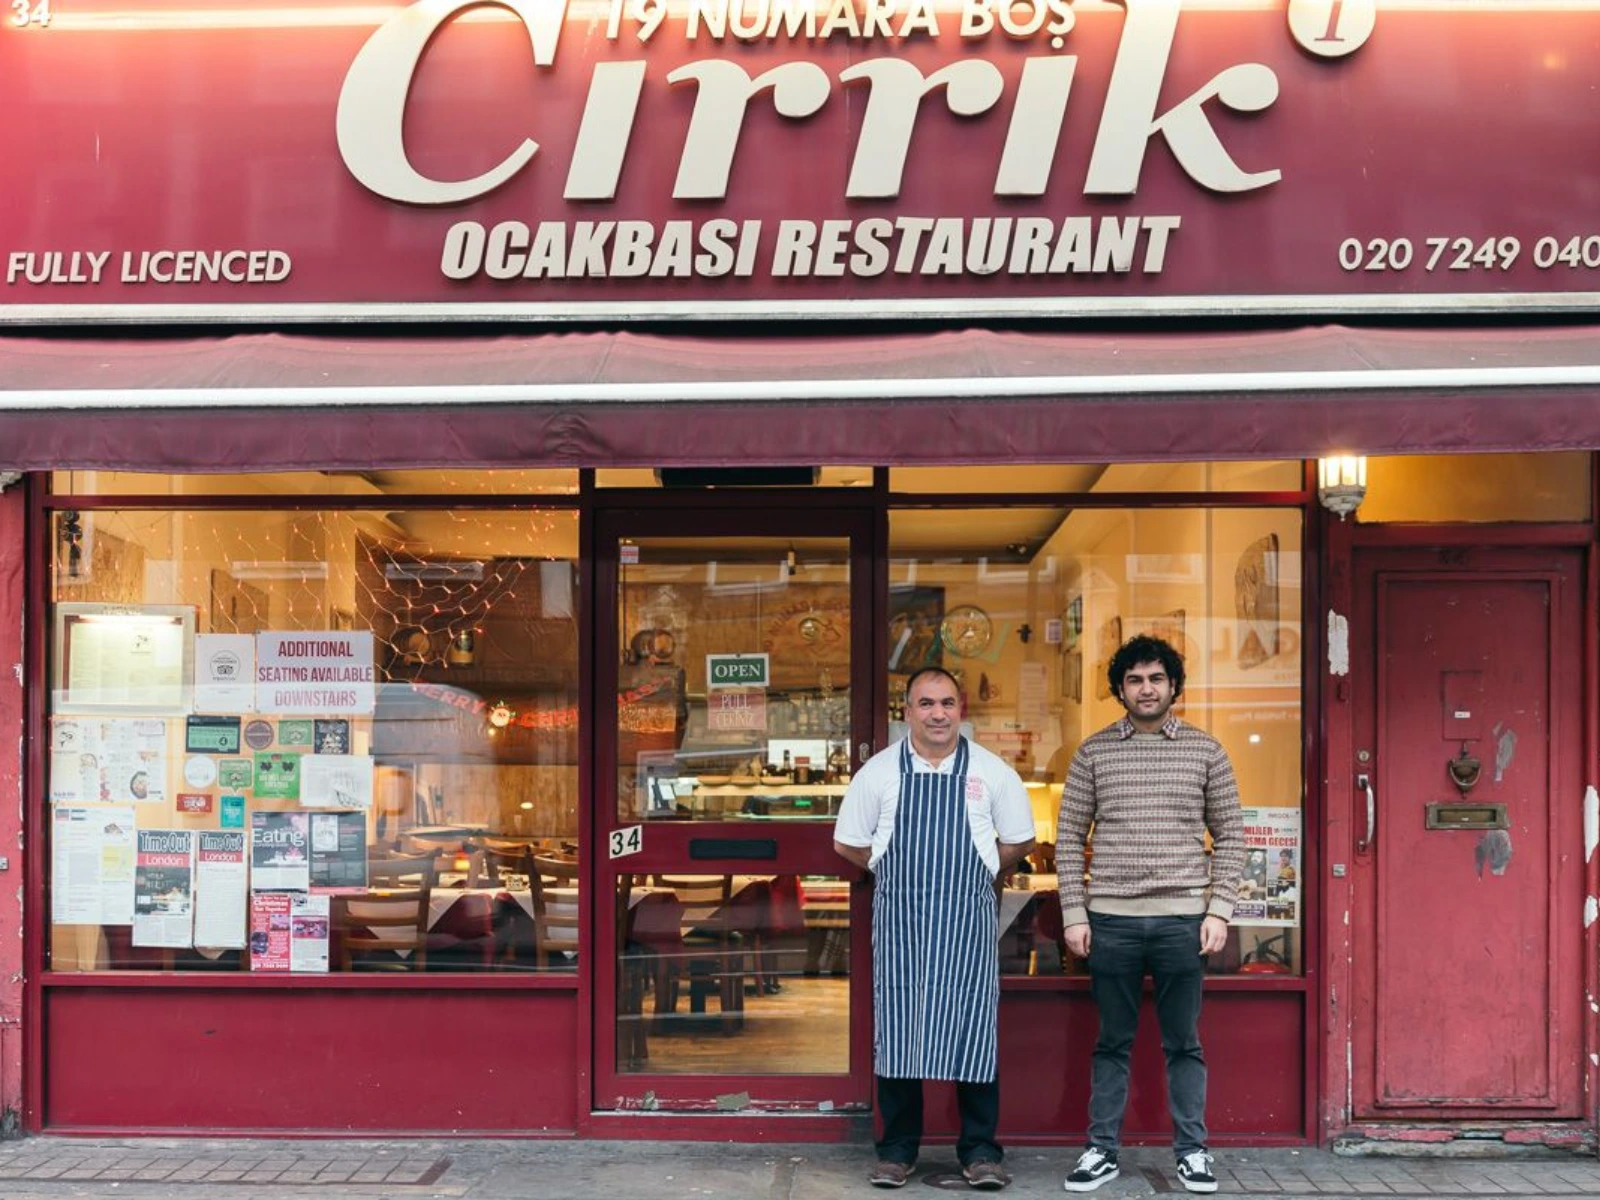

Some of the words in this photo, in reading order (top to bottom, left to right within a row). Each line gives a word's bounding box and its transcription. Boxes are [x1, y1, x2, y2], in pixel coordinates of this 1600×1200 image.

[11, 0, 50, 27] 34
[605, 0, 669, 42] 19
[686, 0, 941, 39] NUMARA
[441, 219, 762, 280] OCAKBASI
[771, 214, 1181, 277] RESTAURANT
[1338, 237, 1413, 271] 020
[1426, 238, 1521, 271] 7249
[1533, 235, 1600, 269] 040
[6, 251, 108, 284] FULLY
[120, 250, 292, 283] LICENCED
[278, 640, 354, 657] ADDITIONAL
[258, 667, 308, 683] SEATING
[310, 666, 372, 682] AVAILABLE
[714, 664, 761, 678] OPEN
[274, 689, 357, 707] DOWNSTAIRS
[721, 694, 752, 709] PULL
[252, 828, 305, 847] Eating
[611, 827, 641, 856] 34
[146, 854, 184, 865] London
[204, 852, 237, 862] London
